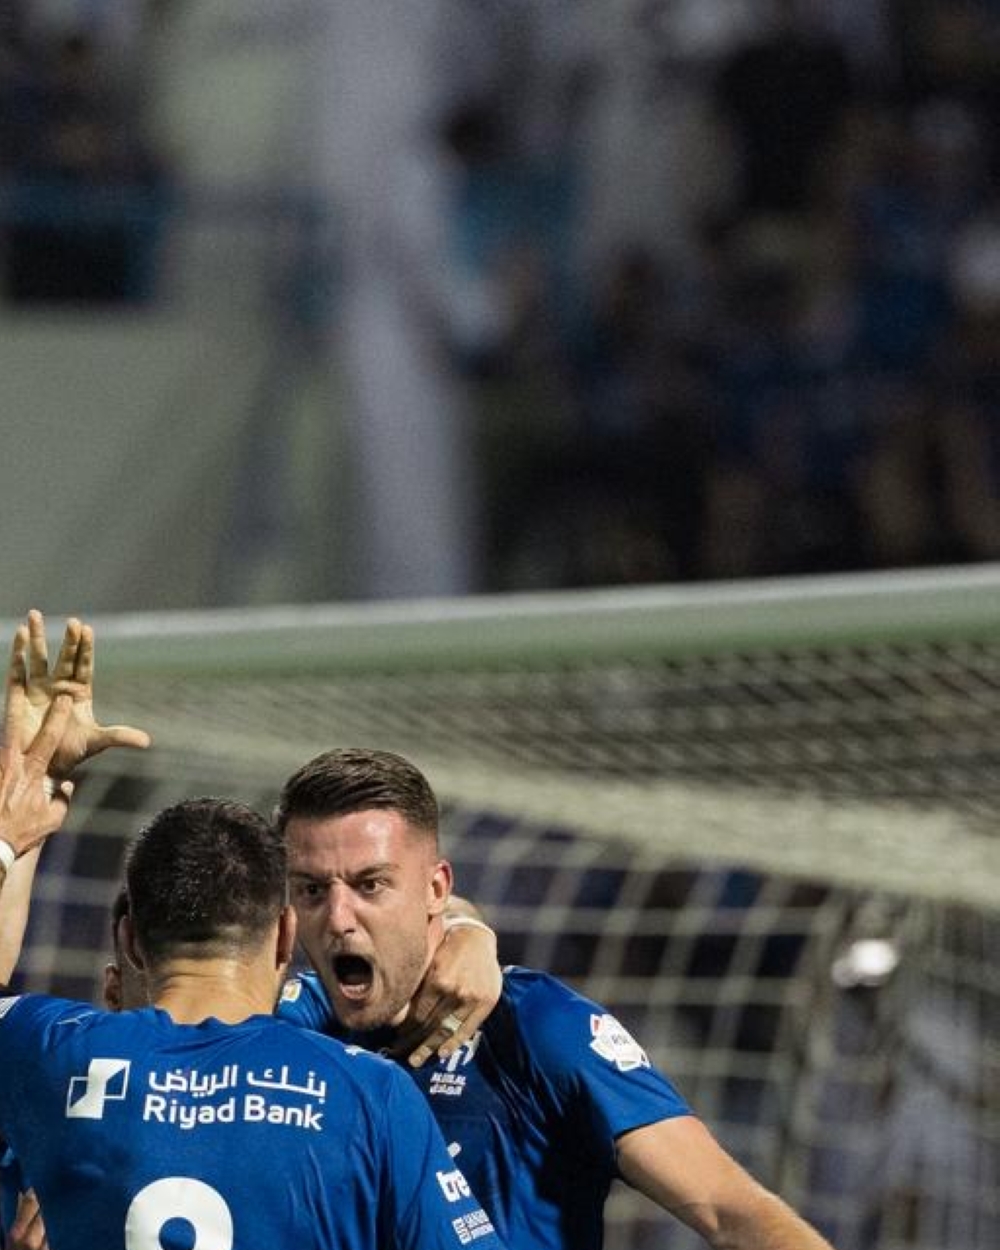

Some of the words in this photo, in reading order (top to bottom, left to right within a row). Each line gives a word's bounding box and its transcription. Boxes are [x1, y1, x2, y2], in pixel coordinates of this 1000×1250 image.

[148, 1064, 239, 1098] الرياض
[143, 1093, 236, 1130] Riyad
[244, 1094, 323, 1131] Bank
